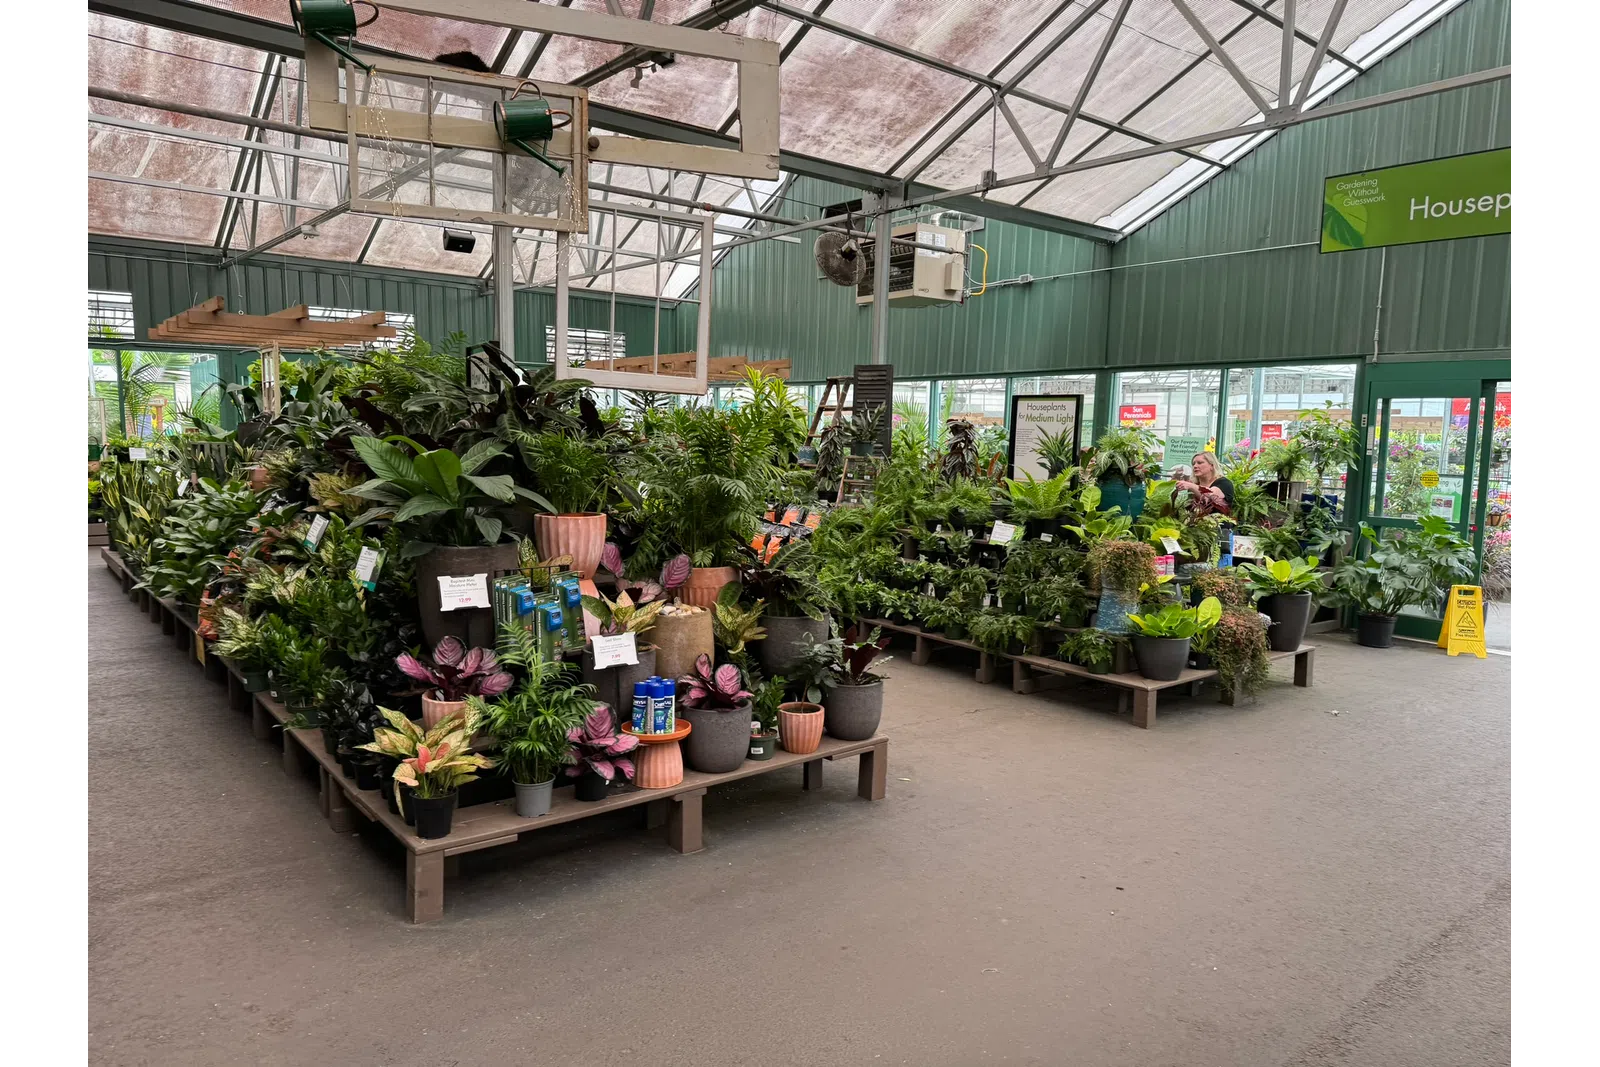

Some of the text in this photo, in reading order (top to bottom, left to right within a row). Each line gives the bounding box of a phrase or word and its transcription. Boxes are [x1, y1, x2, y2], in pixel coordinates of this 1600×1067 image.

[1336, 179, 1378, 191] Gardening
[1348, 187, 1379, 198] Without
[1343, 192, 1386, 207] Guesswork
[1026, 402, 1067, 413] Houseplants
[1018, 412, 1026, 420] for
[1025, 413, 1055, 423] Medium
[1056, 413, 1075, 425] Light
[1123, 411, 1152, 419] Perennials
